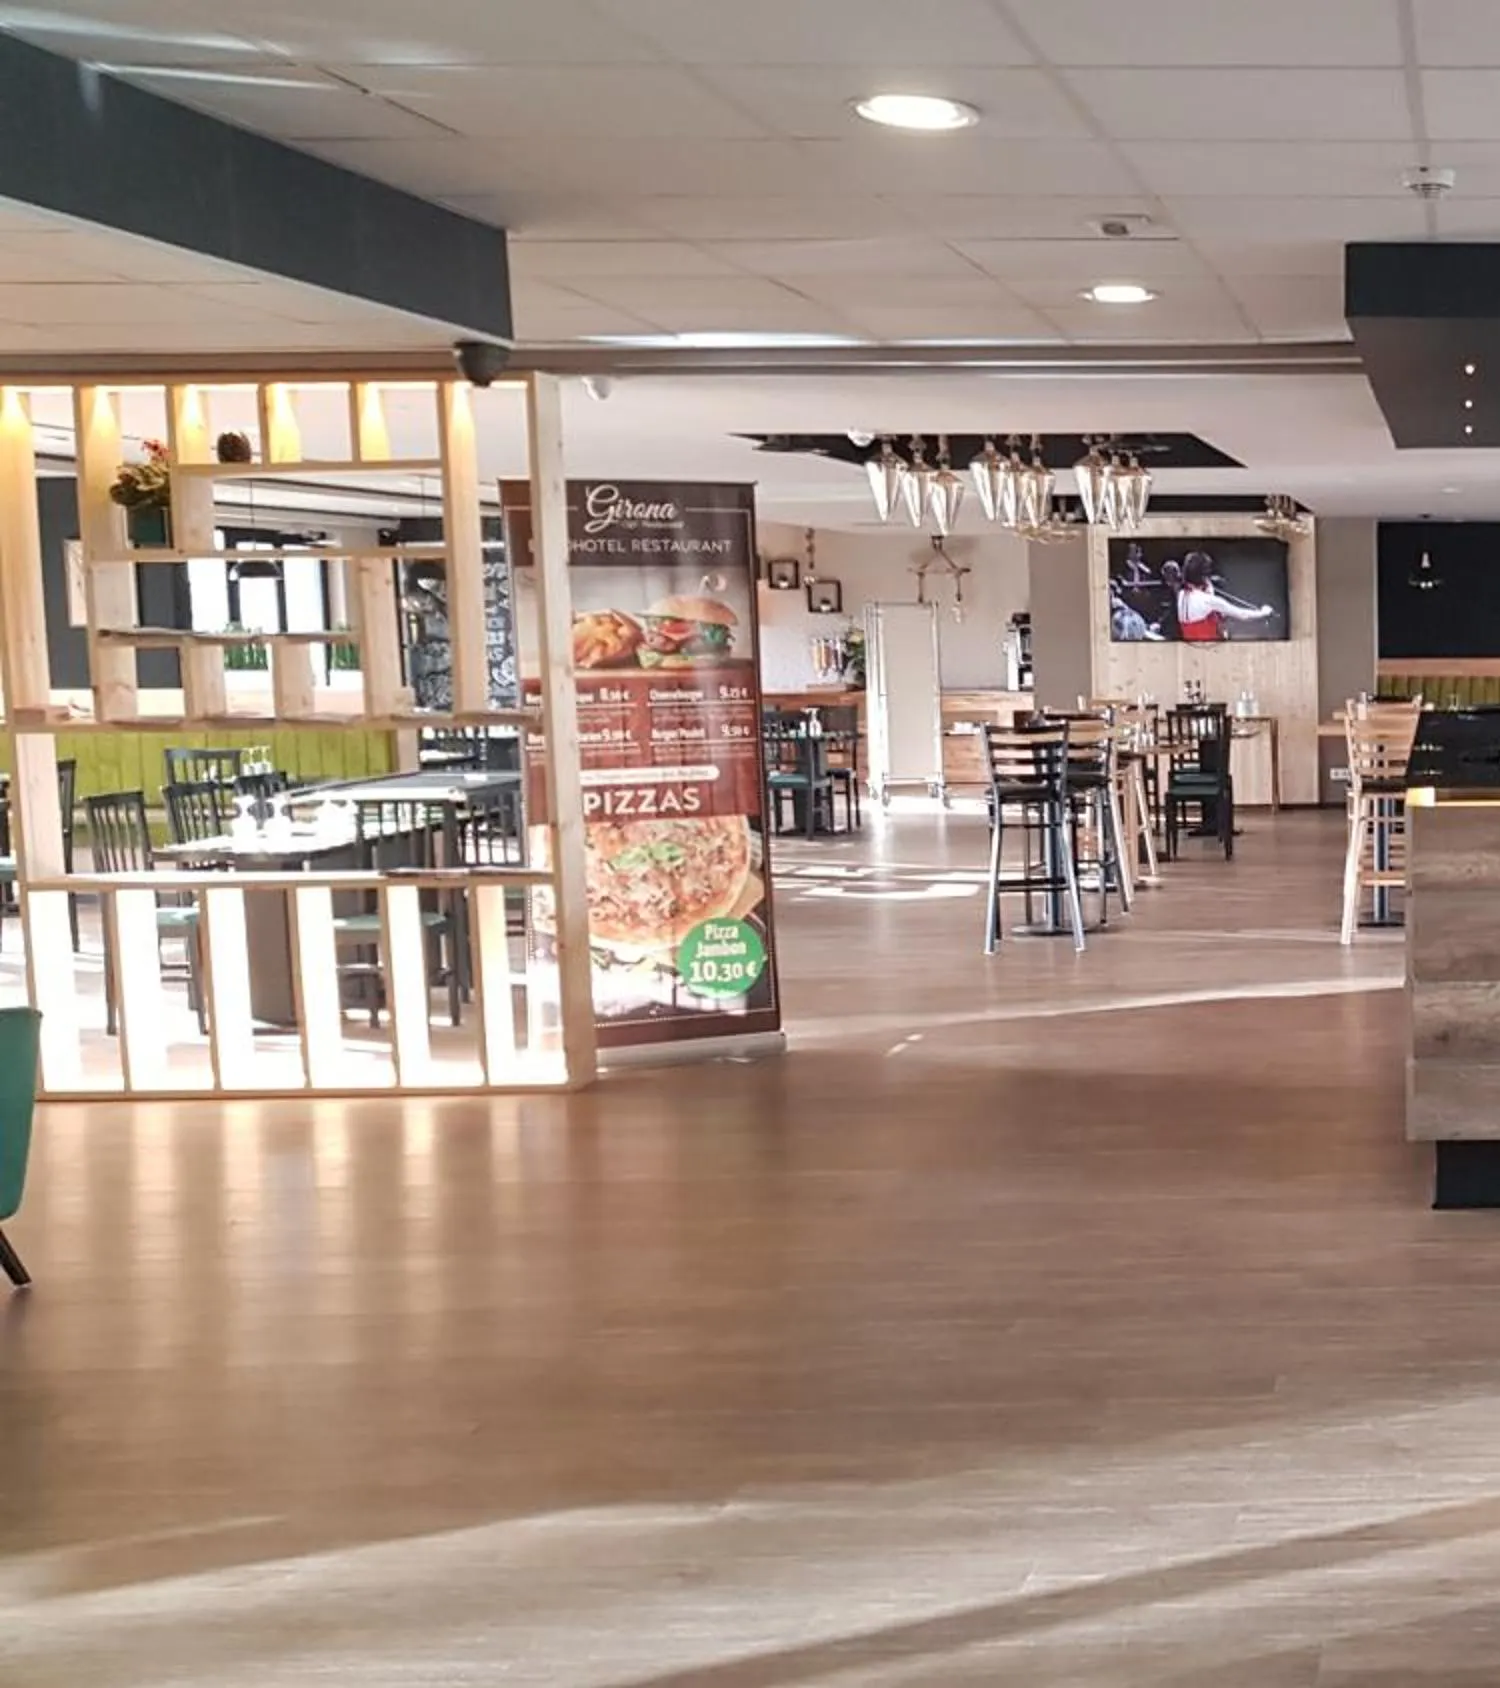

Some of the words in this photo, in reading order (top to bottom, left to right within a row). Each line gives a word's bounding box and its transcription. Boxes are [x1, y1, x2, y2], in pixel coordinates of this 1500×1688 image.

[631, 538, 732, 554] RESTAURANT
[583, 787, 701, 816] PIZZAS
[704, 924, 739, 940] Pizza
[695, 940, 747, 958] Jambon
[690, 961, 743, 983] 10.30
[745, 961, 758, 978] €
